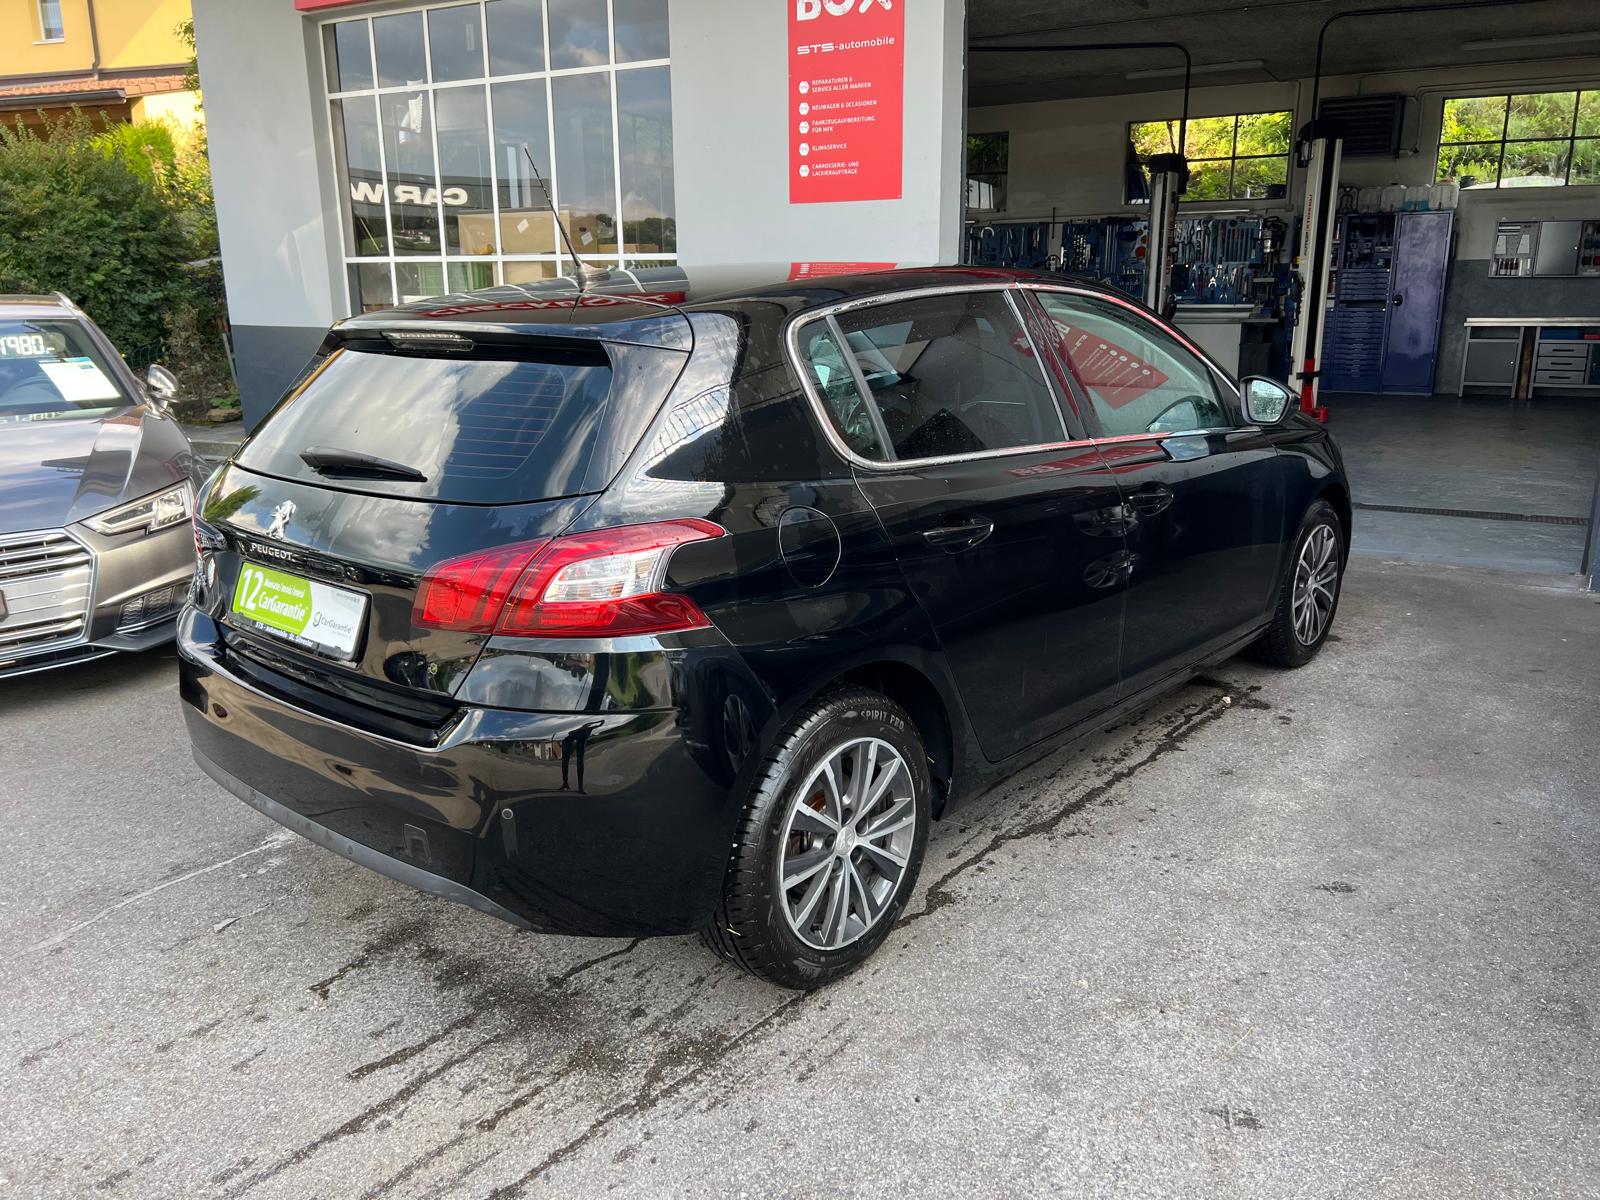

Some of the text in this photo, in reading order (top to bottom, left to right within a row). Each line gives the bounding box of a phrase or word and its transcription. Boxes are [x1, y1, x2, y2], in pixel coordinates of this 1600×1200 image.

[797, 37, 895, 55] STS-automobile
[812, 77, 848, 86] REPARATUREN
[849, 82, 872, 90] MARKEN
[812, 102, 840, 110] NEUWAGEN
[845, 100, 877, 108] OCCASIONEN
[812, 116, 875, 125] FAHRZEUGAUFBEREITUNG
[812, 143, 847, 151] KLIMASERVICE
[251, 543, 293, 560] PEUGEOT
[240, 569, 263, 611] 12
[861, 710, 904, 729] SPIRIT PRO
